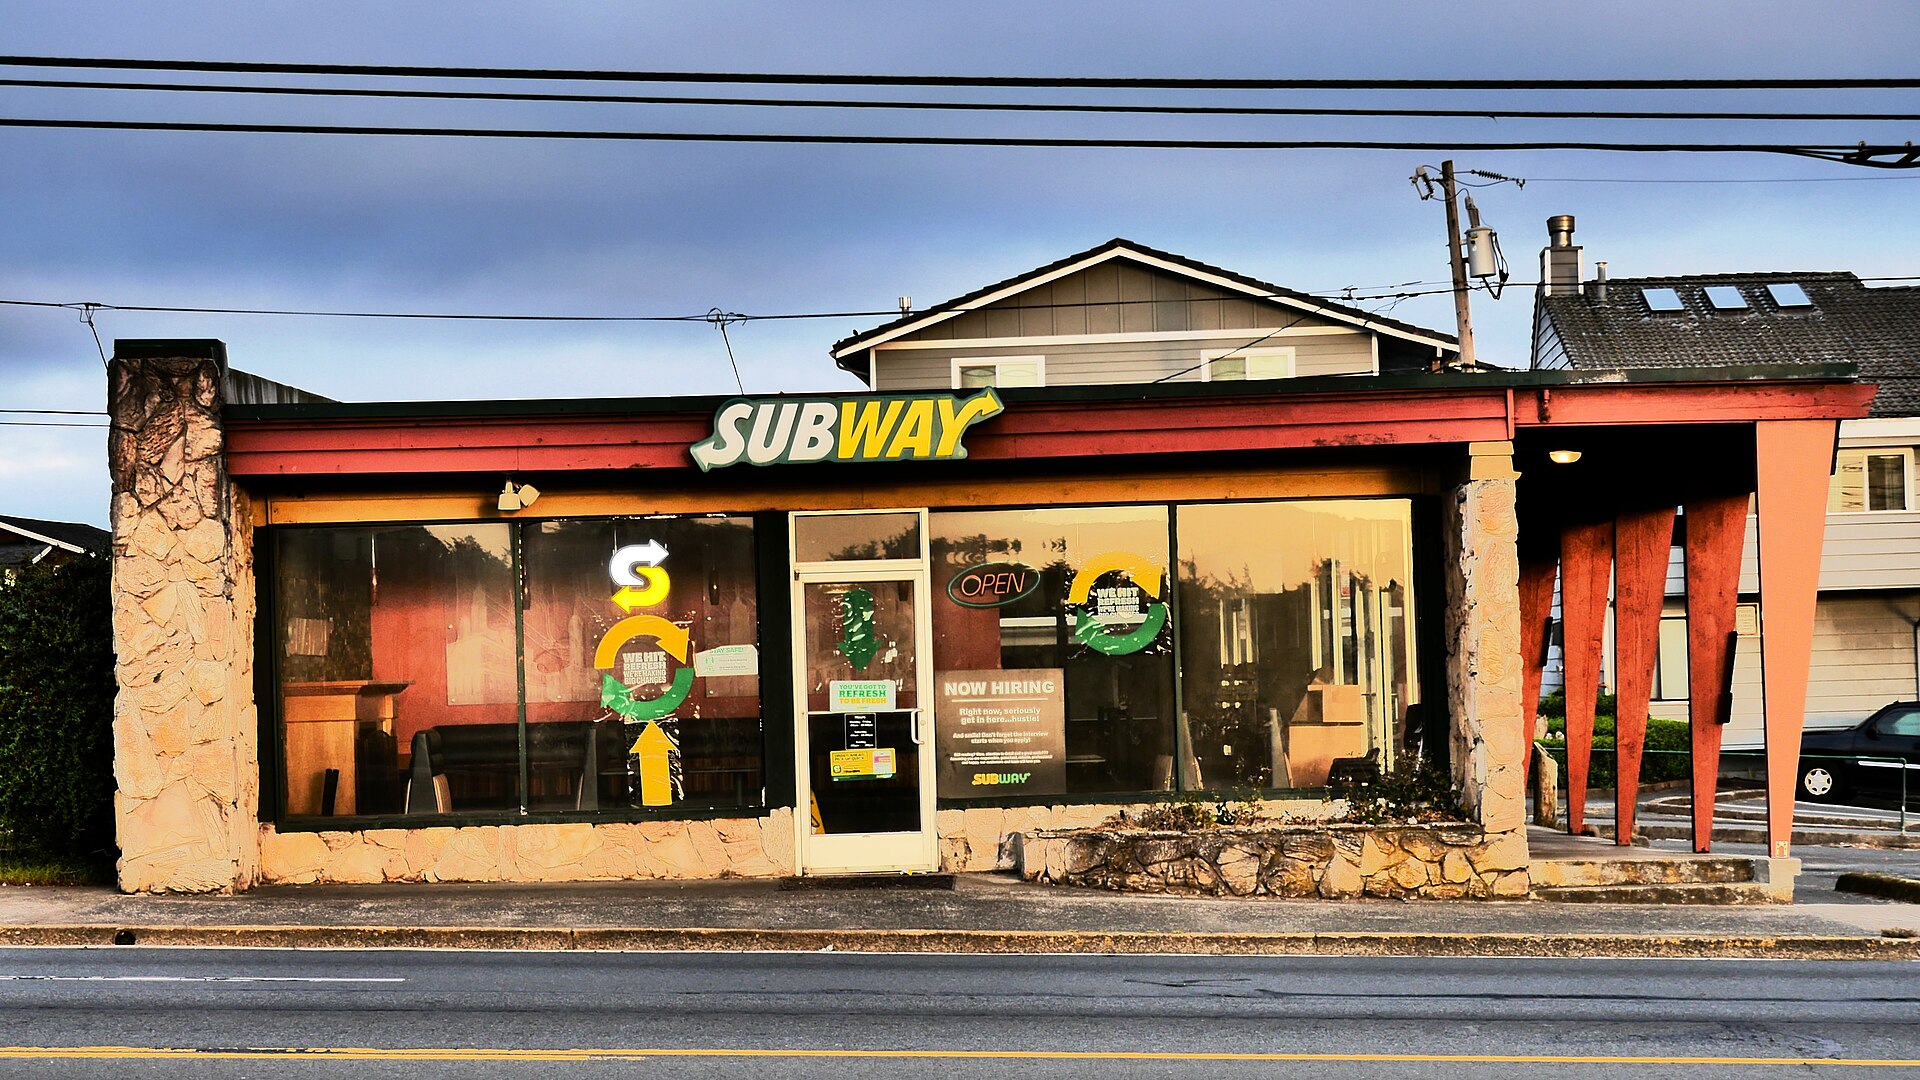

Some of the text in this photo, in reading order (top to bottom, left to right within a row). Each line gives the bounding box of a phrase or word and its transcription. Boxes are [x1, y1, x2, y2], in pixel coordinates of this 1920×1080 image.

[691, 390, 1002, 471] SUBWAY
[961, 572, 1025, 596] OPEN
[1097, 587, 1139, 598] WE HIT
[1097, 597, 1139, 605] REFRESH
[622, 652, 643, 662] WE
[623, 662, 666, 670] REFRESH
[944, 680, 1055, 696] NOW HIRING
[839, 690, 887, 698] REFRESH
[959, 707, 1041, 716] Right now, seriously
[961, 716, 975, 725] get
[972, 772, 1031, 786] SUBWAY
